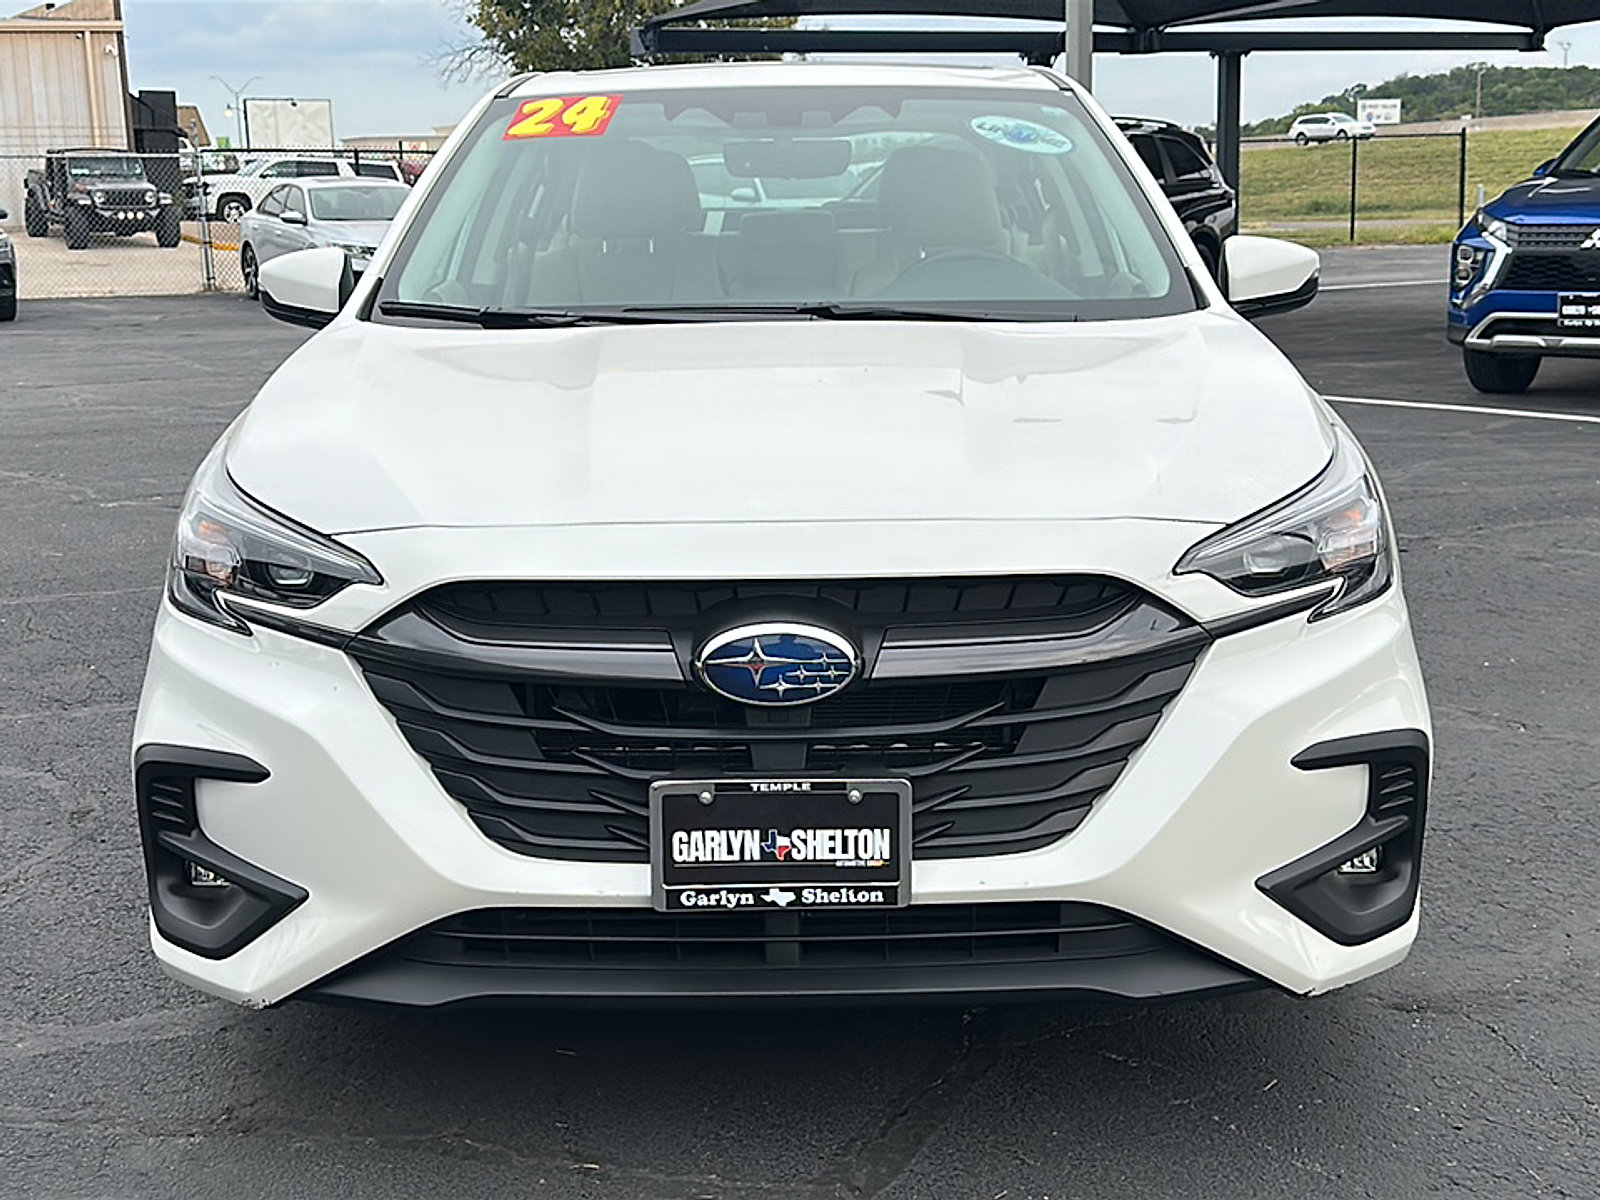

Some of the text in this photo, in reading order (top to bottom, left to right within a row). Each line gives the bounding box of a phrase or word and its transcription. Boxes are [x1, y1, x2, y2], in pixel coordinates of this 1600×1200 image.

[507, 96, 611, 136] 24
[750, 783, 811, 792] TEMPLE
[672, 829, 890, 862] GARLYN SHELTON
[680, 888, 884, 909] Garlyn Shelton
